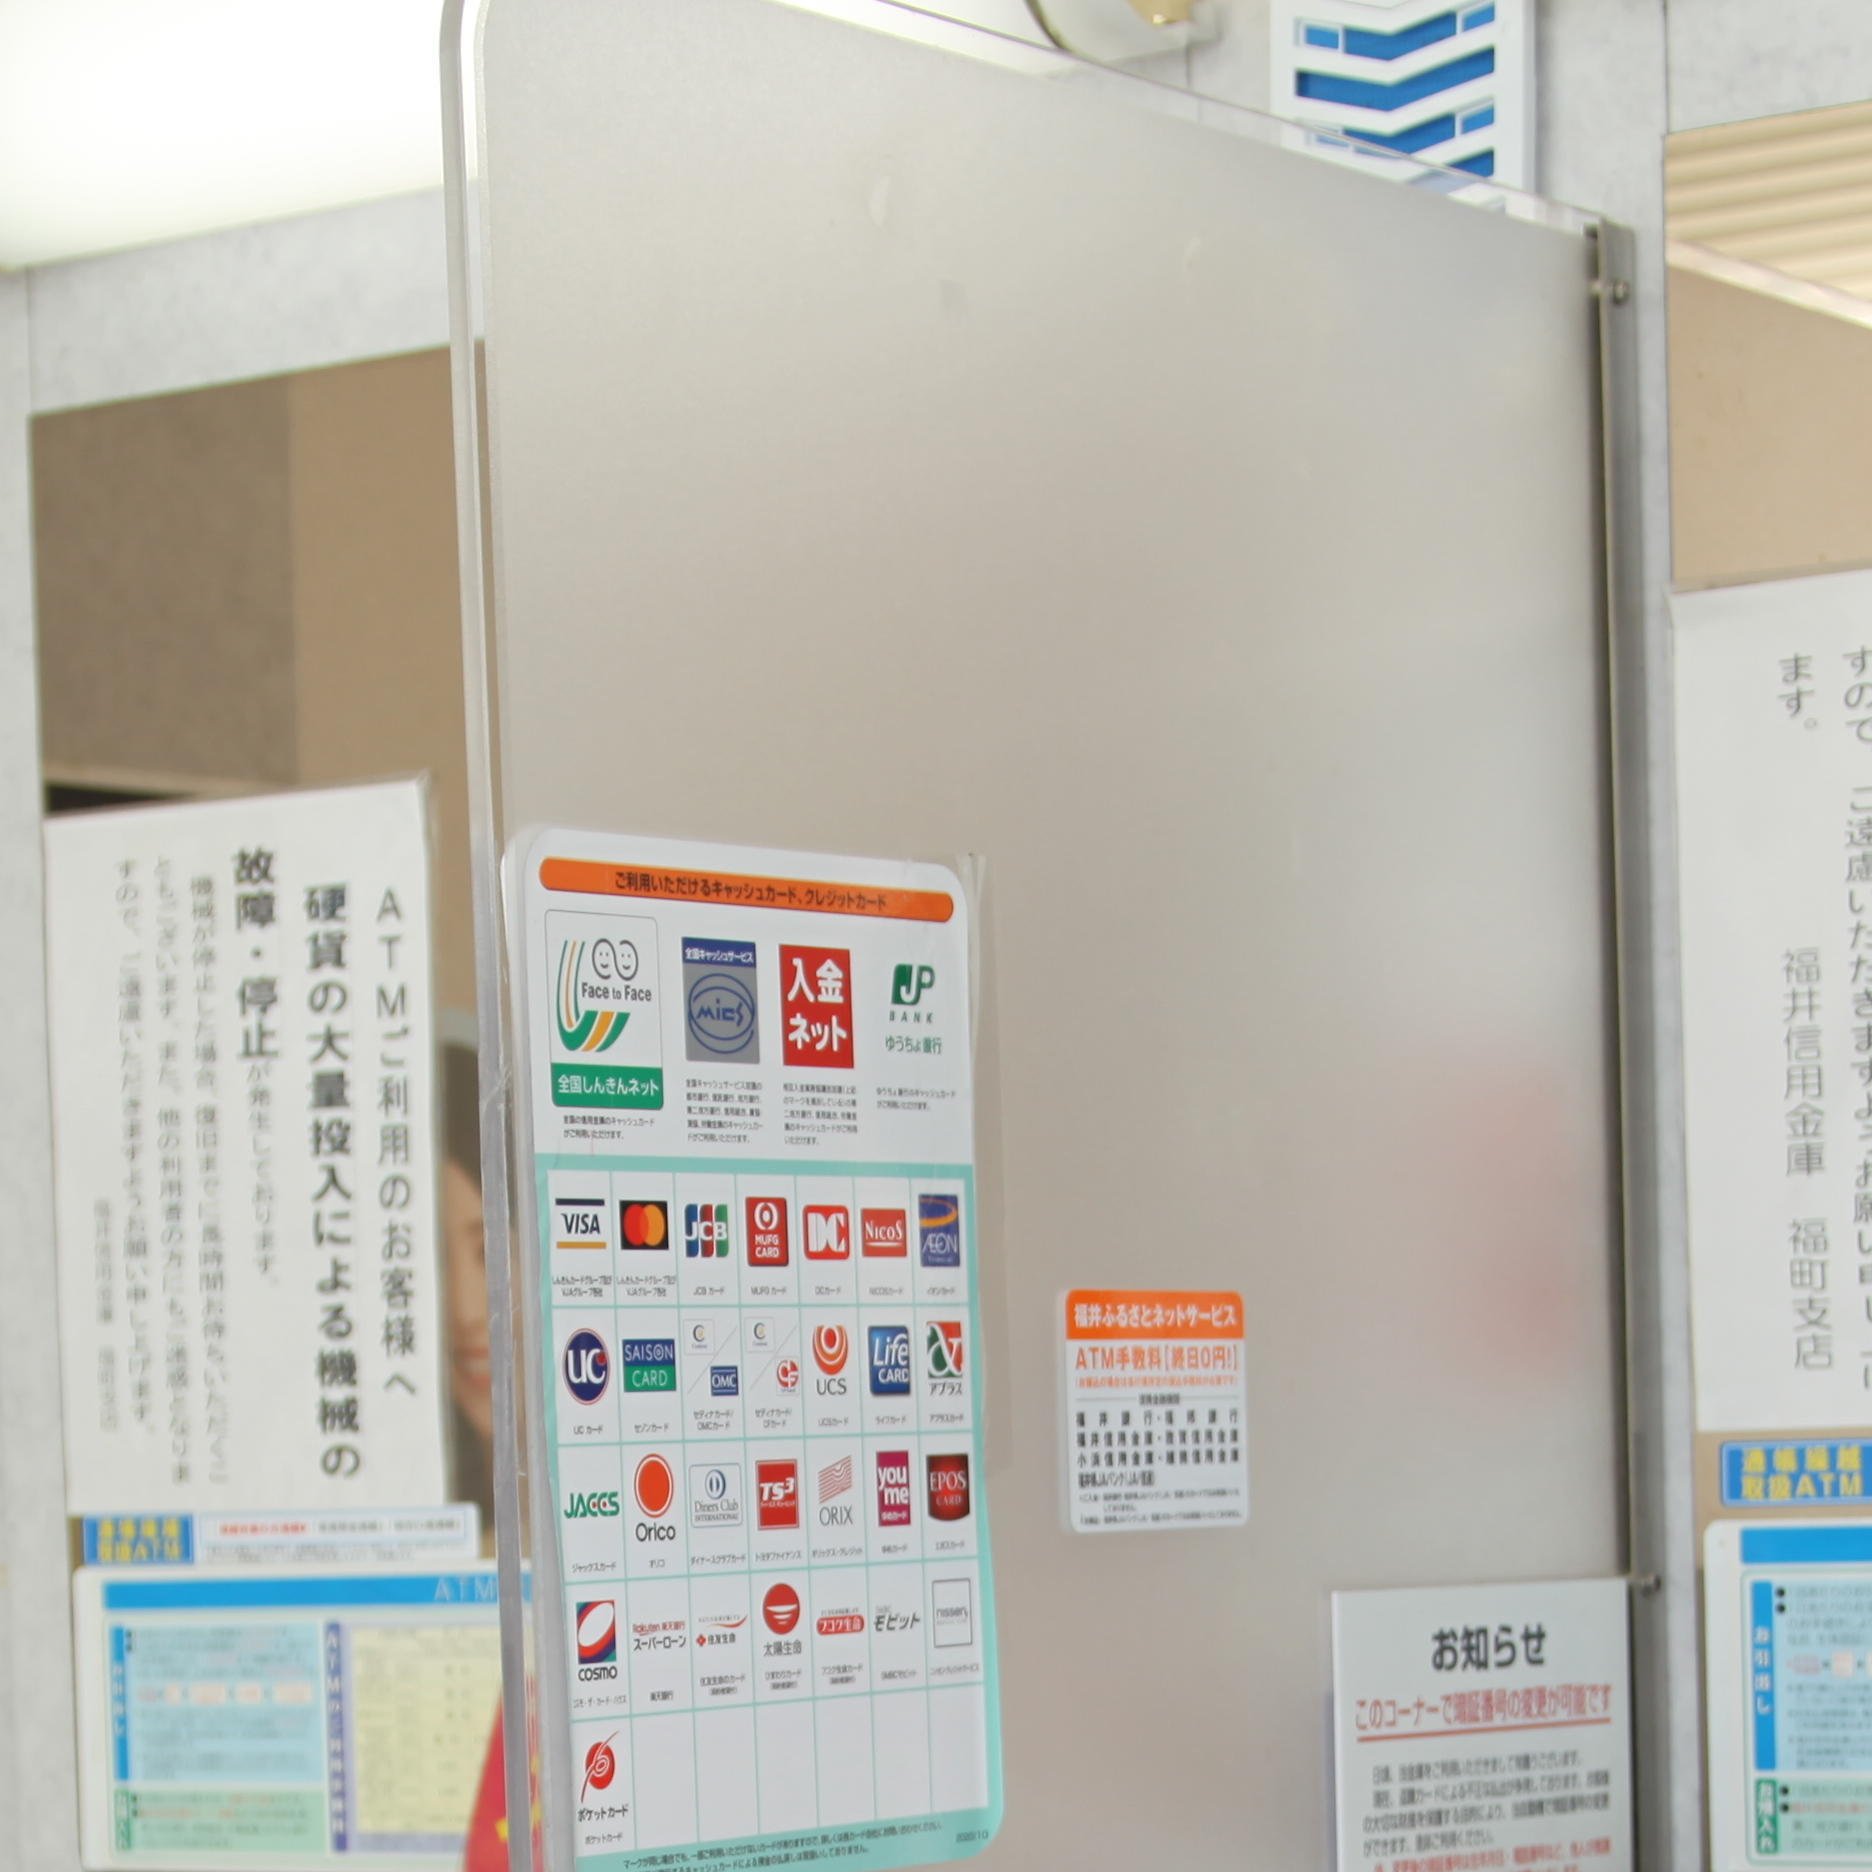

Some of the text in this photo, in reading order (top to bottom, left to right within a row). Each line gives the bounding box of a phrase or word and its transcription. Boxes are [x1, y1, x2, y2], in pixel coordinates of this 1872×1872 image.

[1777, 652, 1820, 732] ます。
[787, 957, 844, 1004] 入金
[581, 982, 652, 1002] Face to Face
[889, 1010, 934, 1024] BANK
[788, 1013, 848, 1052] ネット
[885, 1035, 943, 1055] ゆうちょ銀行
[557, 1074, 659, 1097] 全国しんきんネット
[375, 887, 419, 1398] ATMご利用のお客様へ
[1781, 947, 1835, 1372] 福井信用金庫 福町支店
[303, 882, 361, 1480] 硬貨の大量投入による機械の
[560, 1212, 601, 1235] VISA
[684, 1221, 729, 1241] JCB
[806, 1212, 847, 1253] DC
[754, 1234, 779, 1246] MUFG
[755, 1246, 780, 1258] CARD
[1073, 1303, 1237, 1329] 福井ふるさとネットサービス
[624, 1344, 674, 1362] SAISON
[873, 1333, 909, 1366] Life
[566, 1348, 606, 1384] UC
[878, 1368, 909, 1383] CARD
[632, 1370, 668, 1387] CARD
[711, 1374, 737, 1388] OMC
[816, 1379, 847, 1395] UCS
[929, 1382, 963, 1396] アプラス
[878, 1467, 907, 1489] you
[930, 1471, 966, 1492] EPOS
[564, 1491, 620, 1519] JACCS
[720, 1498, 739, 1511] Club
[884, 1486, 909, 1505] me
[819, 1505, 853, 1526] ORIX
[635, 1522, 676, 1542] Orico
[873, 1612, 921, 1633] モビット
[633, 1635, 687, 1651] スーパーローン
[763, 1639, 803, 1657] 太陽生命
[1431, 1622, 1547, 1672] お知らせ
[577, 1805, 629, 1823] ポケットカード
